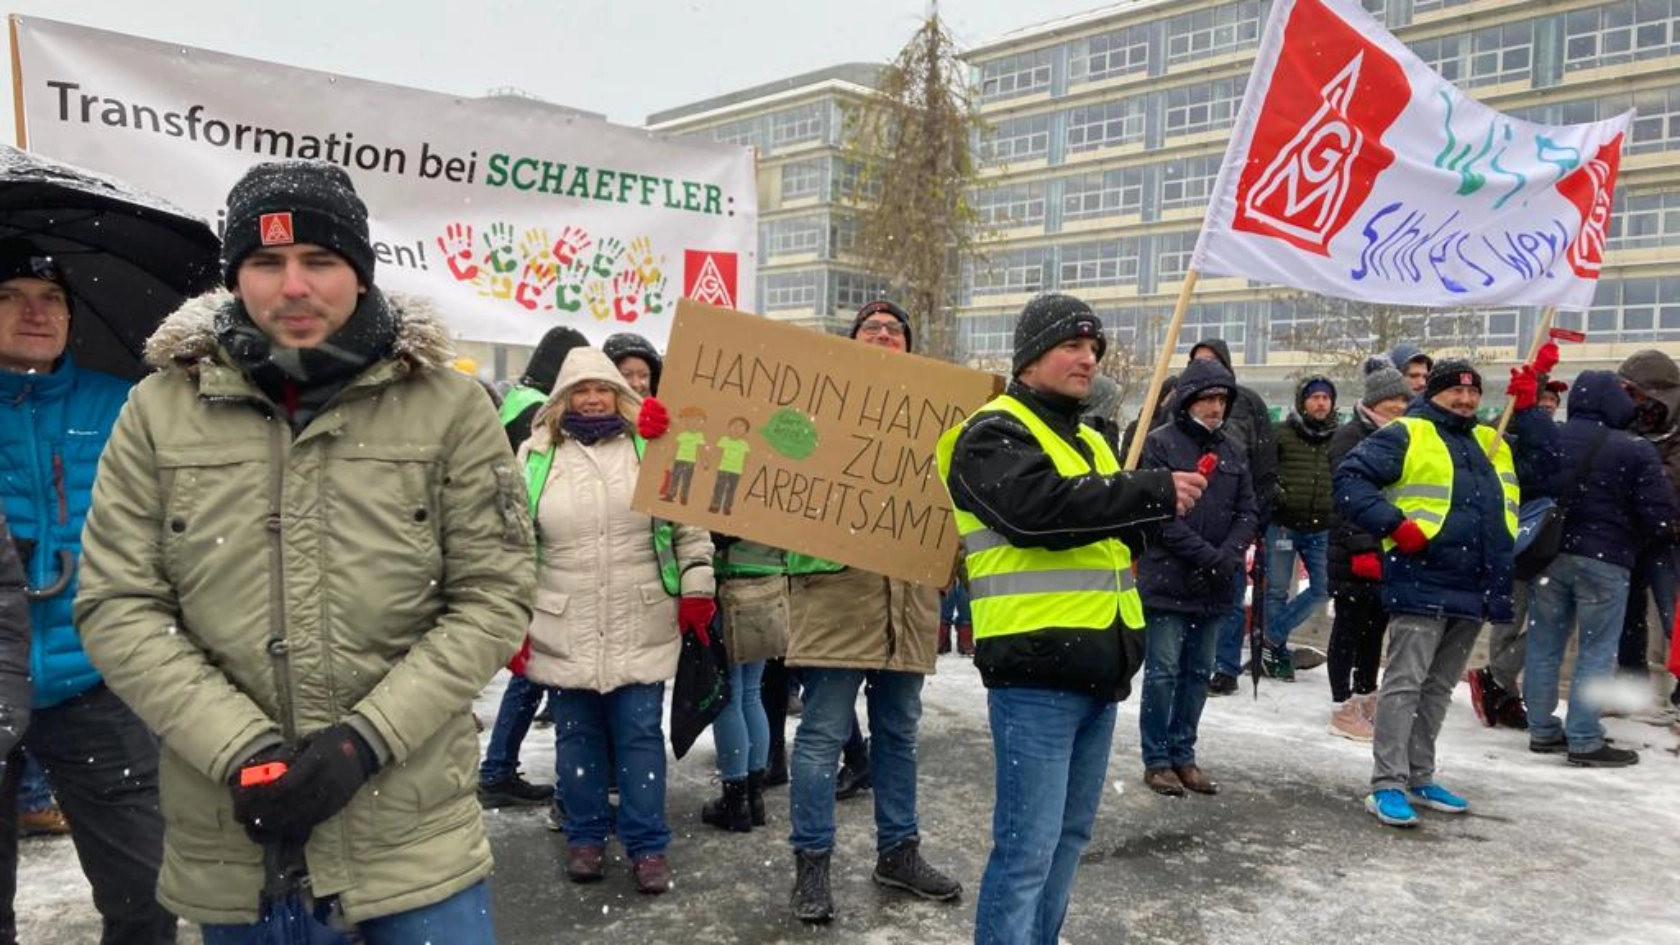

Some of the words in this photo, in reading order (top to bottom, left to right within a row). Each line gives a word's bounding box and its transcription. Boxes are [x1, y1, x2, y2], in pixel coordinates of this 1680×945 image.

[46, 79, 406, 175] Transformation
[418, 142, 478, 184] bei
[485, 153, 735, 217] SCHAEFFLER:
[691, 344, 801, 407] HAND
[807, 372, 851, 421] IN
[842, 433, 935, 493] ZUM
[743, 464, 954, 550] ARBEITSAMT
